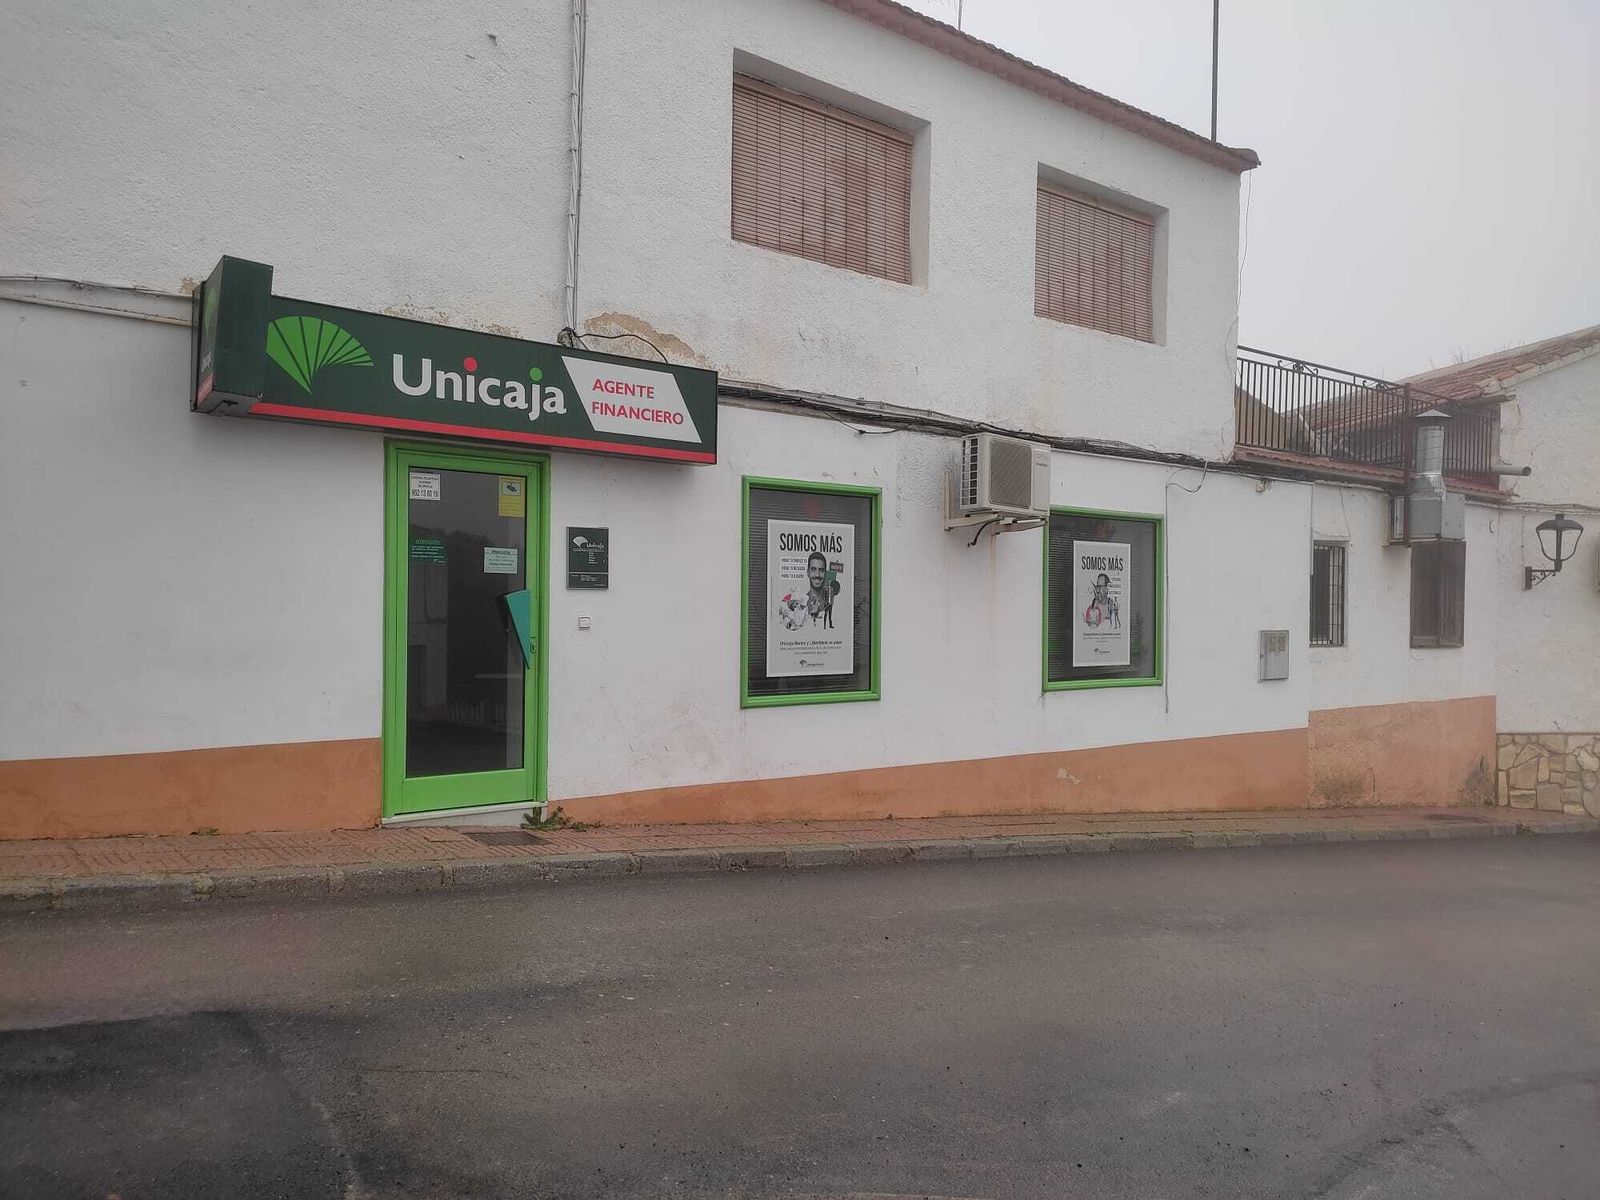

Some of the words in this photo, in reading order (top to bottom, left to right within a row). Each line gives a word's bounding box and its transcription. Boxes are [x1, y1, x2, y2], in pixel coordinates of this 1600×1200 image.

[393, 353, 567, 421] Unicaja
[592, 379, 655, 399] AGENTE
[592, 401, 684, 425] FINANCIERO
[780, 533, 817, 552] SOMOS
[820, 532, 843, 553] MÁS
[1081, 556, 1107, 571] SOMOS
[1108, 555, 1124, 572] MÁS
